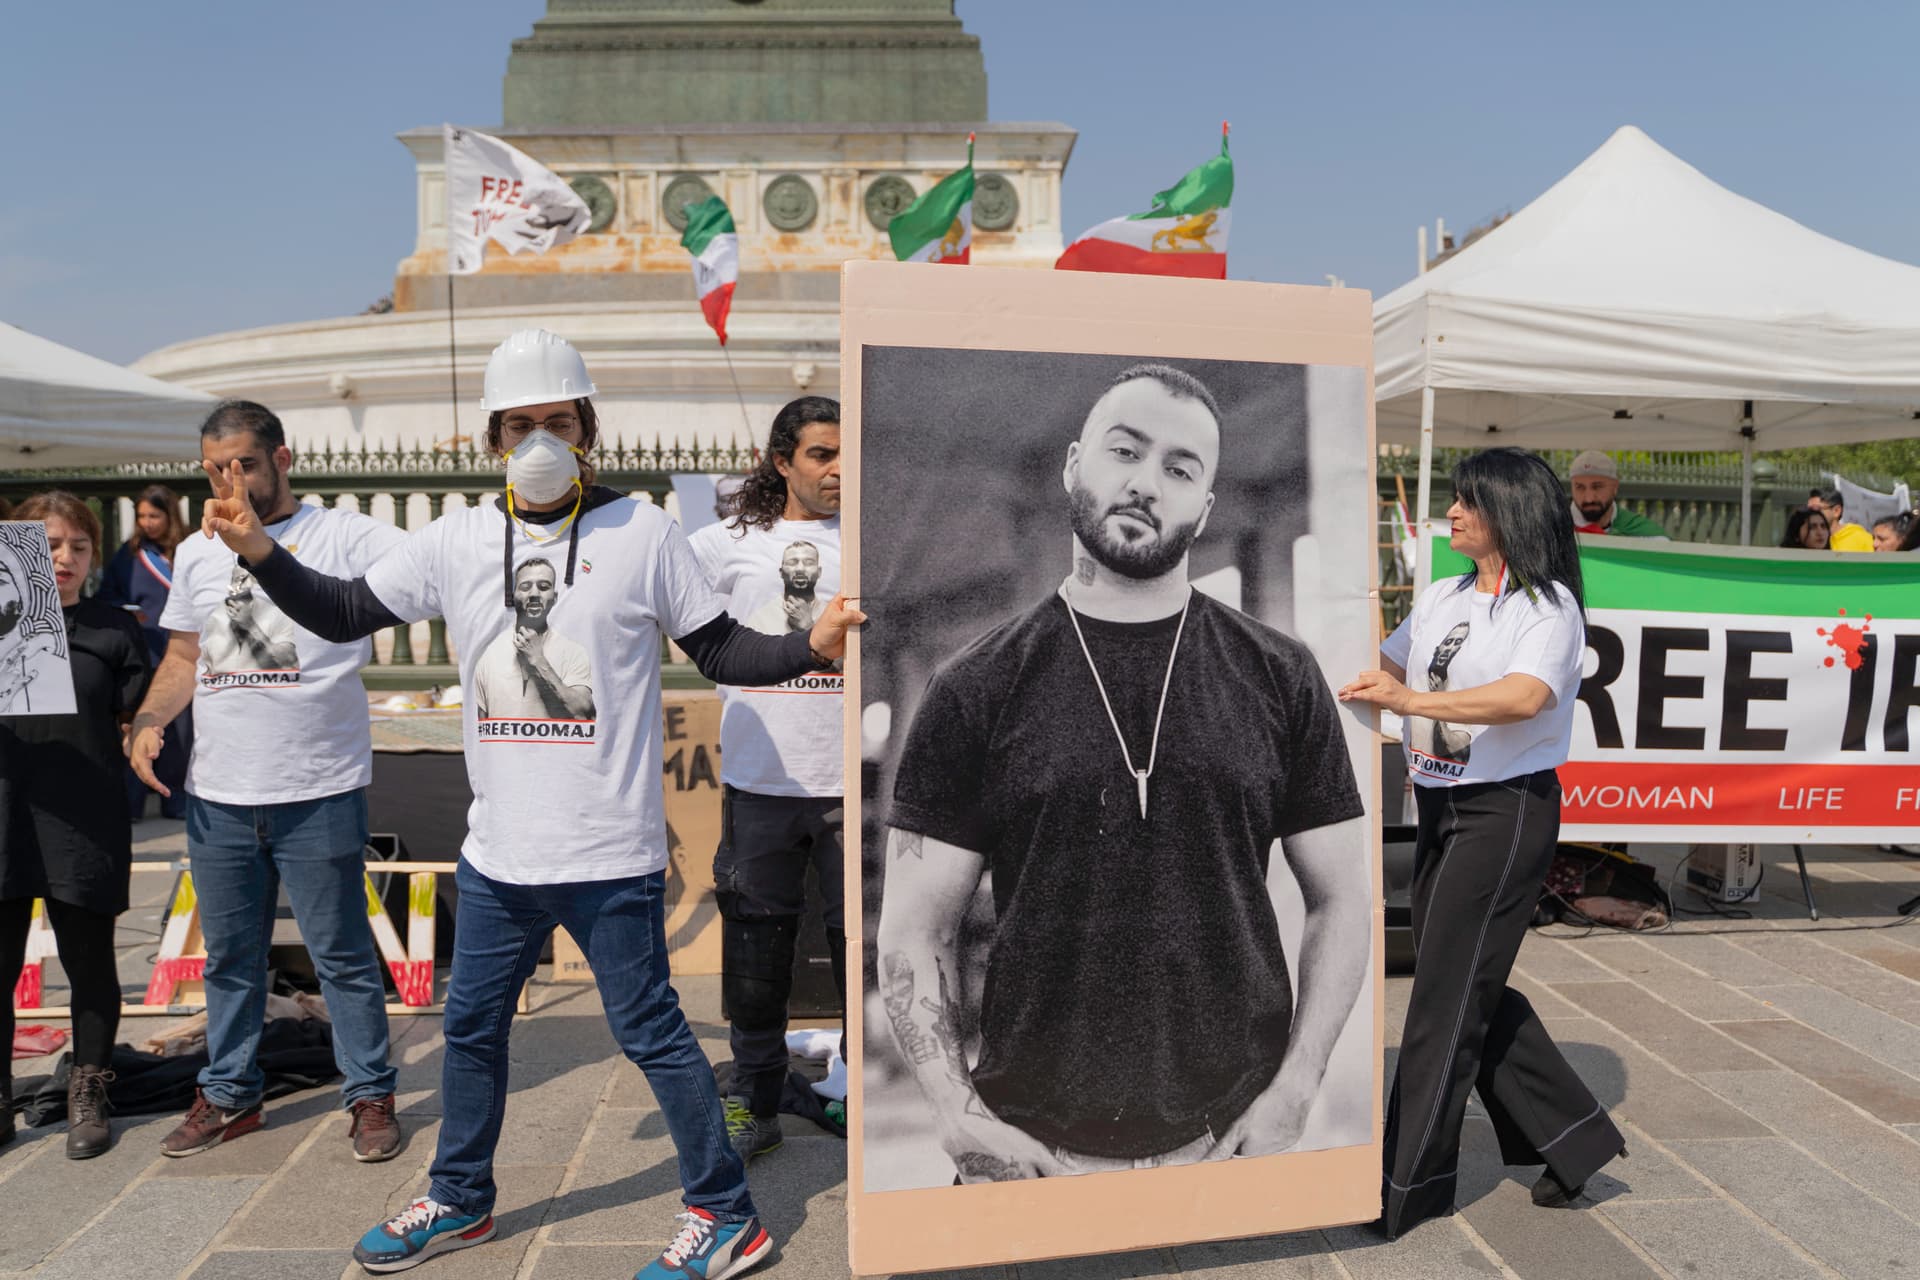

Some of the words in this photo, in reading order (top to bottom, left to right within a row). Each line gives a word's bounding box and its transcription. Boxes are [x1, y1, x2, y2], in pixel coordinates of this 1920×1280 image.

[1576, 625, 1793, 751] REE
[663, 706, 687, 741] E
[1561, 785, 1714, 809] WOMAN
[1778, 787, 1845, 810] LIFE
[1896, 788, 1920, 811] F
